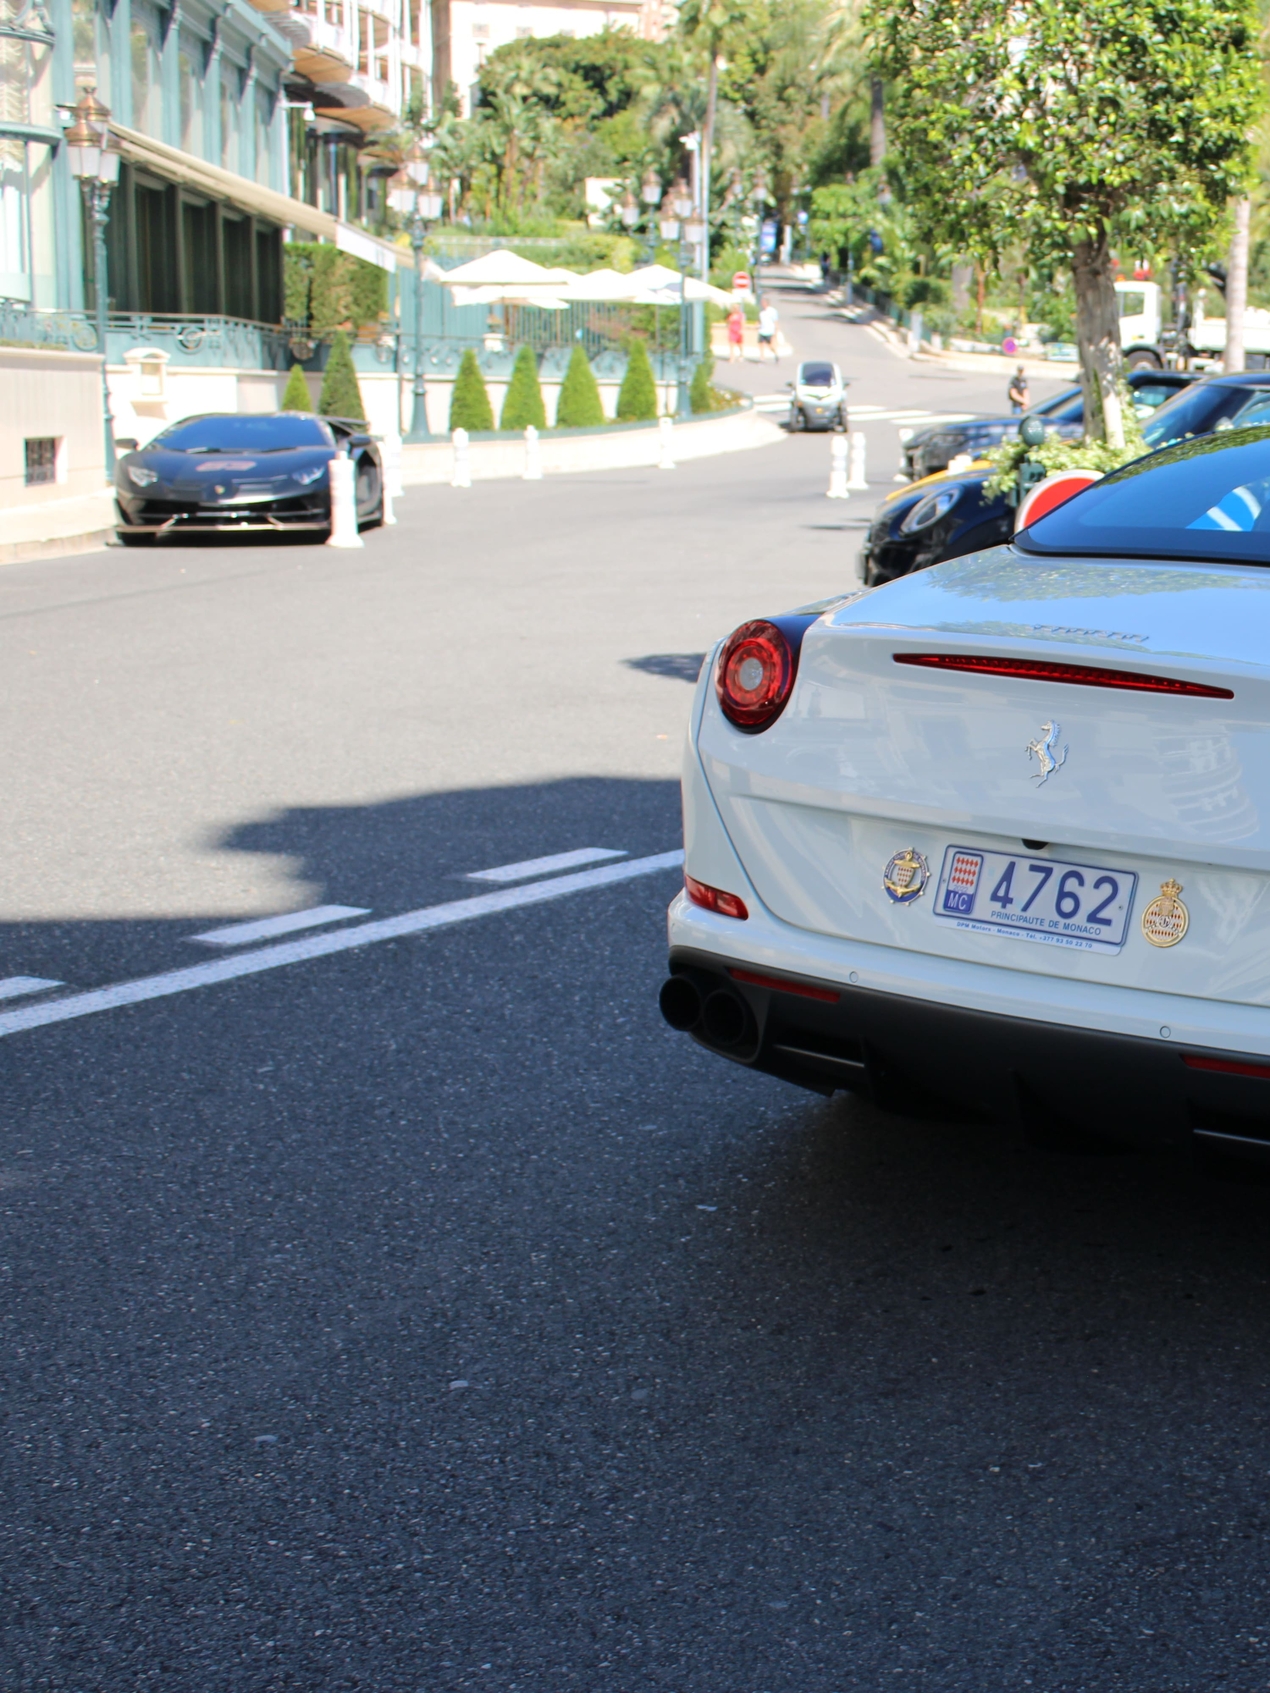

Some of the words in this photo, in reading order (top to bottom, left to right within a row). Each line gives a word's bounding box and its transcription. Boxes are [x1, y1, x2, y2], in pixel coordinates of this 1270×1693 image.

[947, 892, 968, 910] MC
[989, 861, 1120, 926] 4762
[971, 923, 991, 932] Motors
[996, 928, 1020, 937] Monaco
[990, 910, 1045, 927] PRINCIPAUTE
[1048, 920, 1060, 929] DE
[1062, 922, 1102, 936] MONACO
